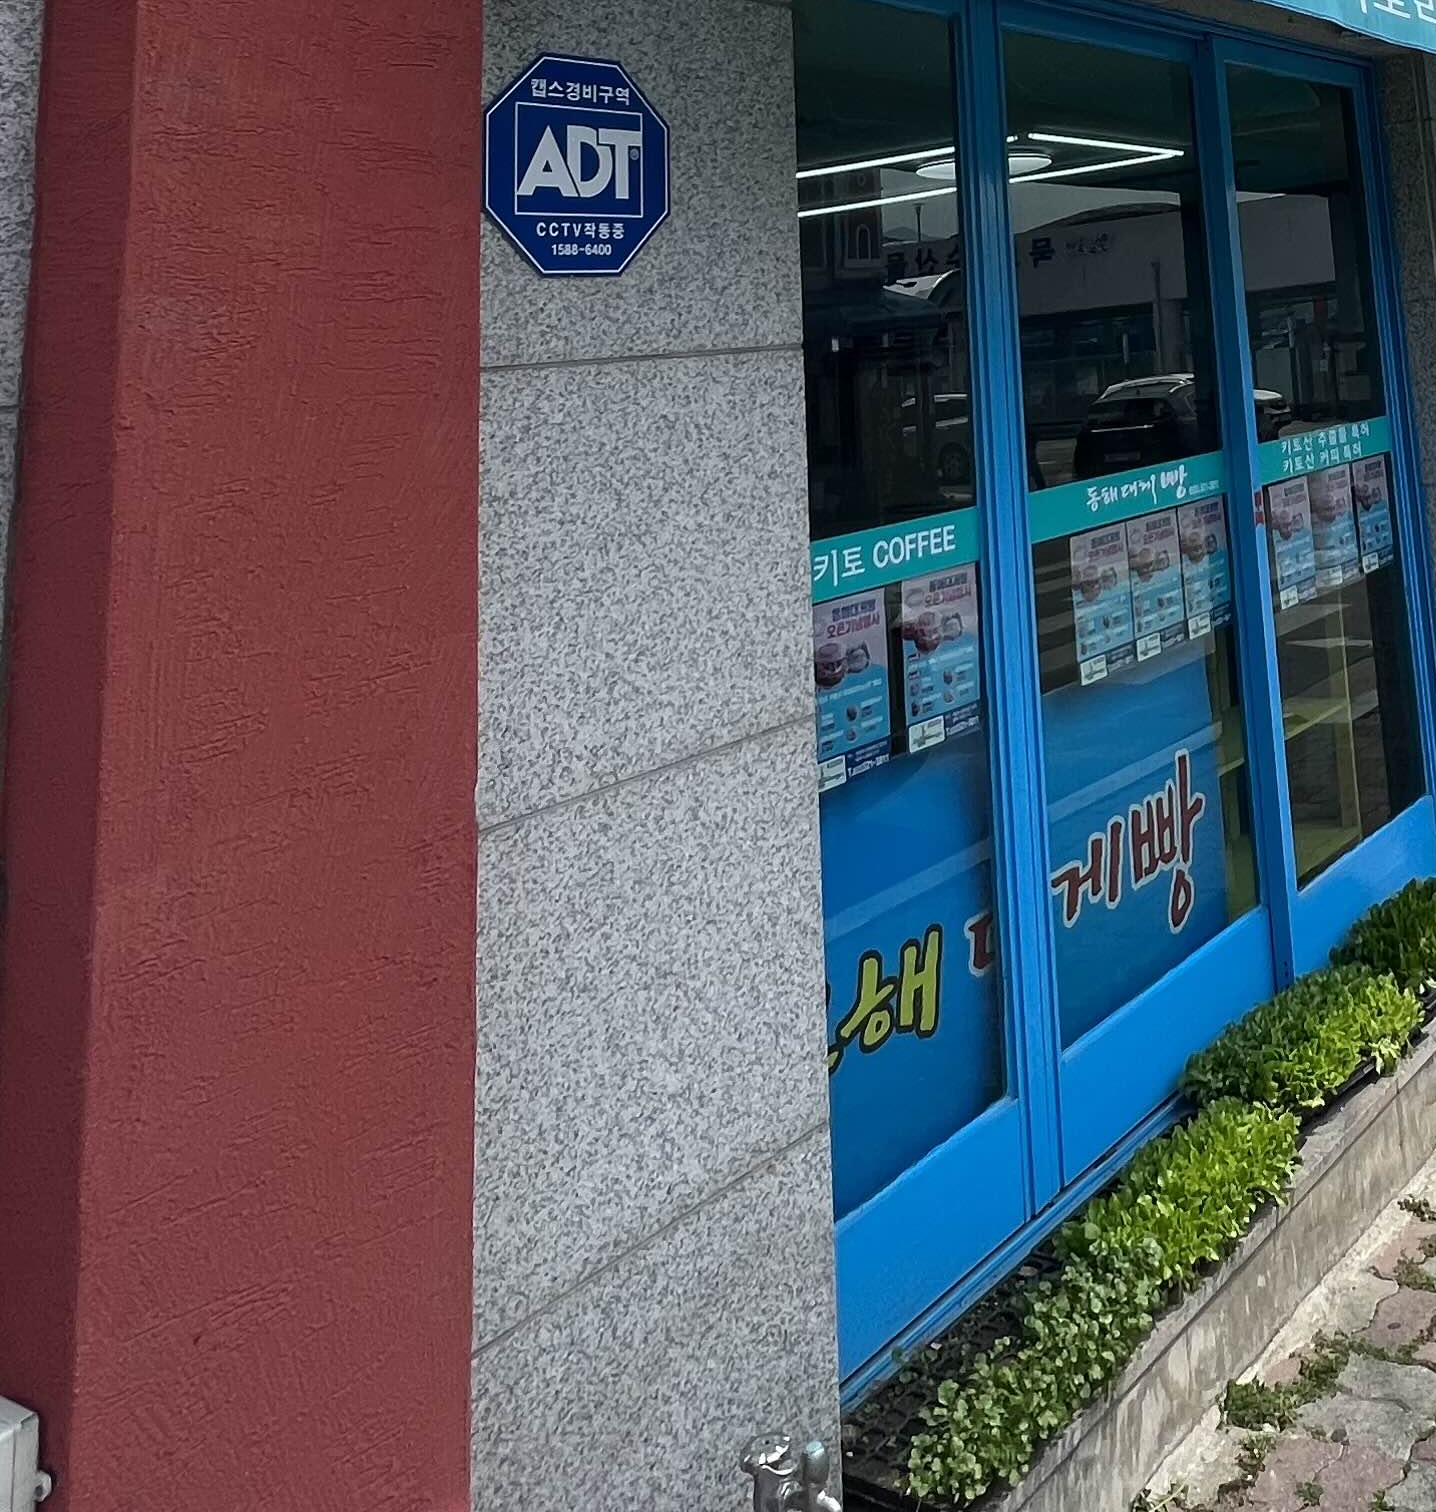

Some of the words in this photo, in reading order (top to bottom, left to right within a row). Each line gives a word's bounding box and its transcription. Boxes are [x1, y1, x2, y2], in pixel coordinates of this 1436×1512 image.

[516, 125, 642, 199] ADT
[551, 244, 612, 256] 1588-6400
[1281, 432, 1313, 455] 키토산
[1281, 452, 1315, 474] 키토산
[813, 546, 865, 586] 키토
[873, 525, 956, 568] COFFEE
[834, 922, 944, 1054] 해
